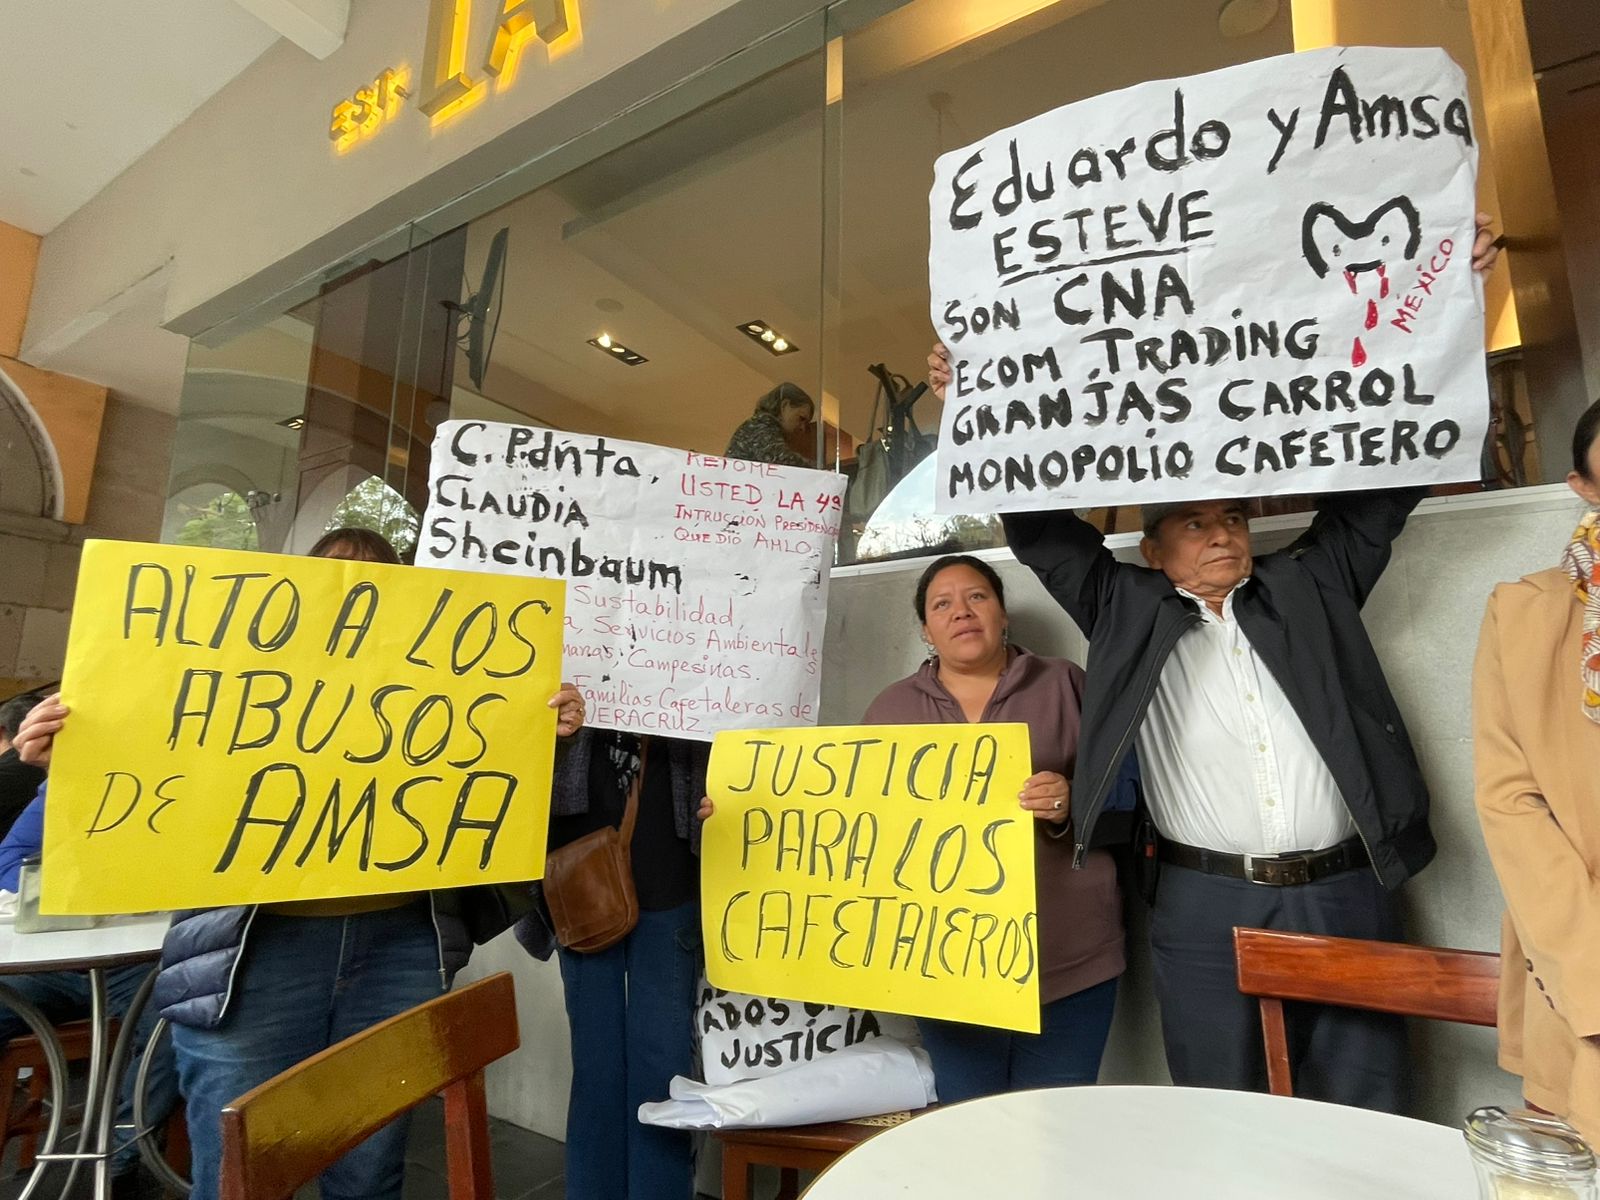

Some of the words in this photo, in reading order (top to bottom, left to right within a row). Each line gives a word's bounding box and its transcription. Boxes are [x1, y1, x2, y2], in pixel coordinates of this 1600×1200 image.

[950, 87, 1231, 231] Eduardo
[1267, 106, 1300, 175] y
[1314, 64, 1473, 151] Amsa
[994, 190, 1214, 276] ESTEVE
[1054, 264, 1195, 326] CNA
[954, 368, 1192, 446] GRANJAS
[1219, 364, 1435, 422] CARROL
[955, 347, 1060, 398] ECOM
[451, 422, 492, 466] C.
[1215, 419, 1461, 476] CAFETERO
[681, 473, 763, 505] USTED
[778, 490, 805, 511] LA
[123, 563, 300, 652] ALTO
[326, 581, 379, 659] A
[406, 588, 552, 678] LOS
[168, 668, 508, 768] ABUSOS
[790, 692, 816, 722] de
[728, 735, 998, 806] JUSTICIA
[85, 771, 187, 839] DE
[214, 763, 519, 874] AMSA
[741, 808, 878, 887] PARA
[894, 818, 1016, 895] LOS
[721, 891, 1038, 986] CAFETALEROS
